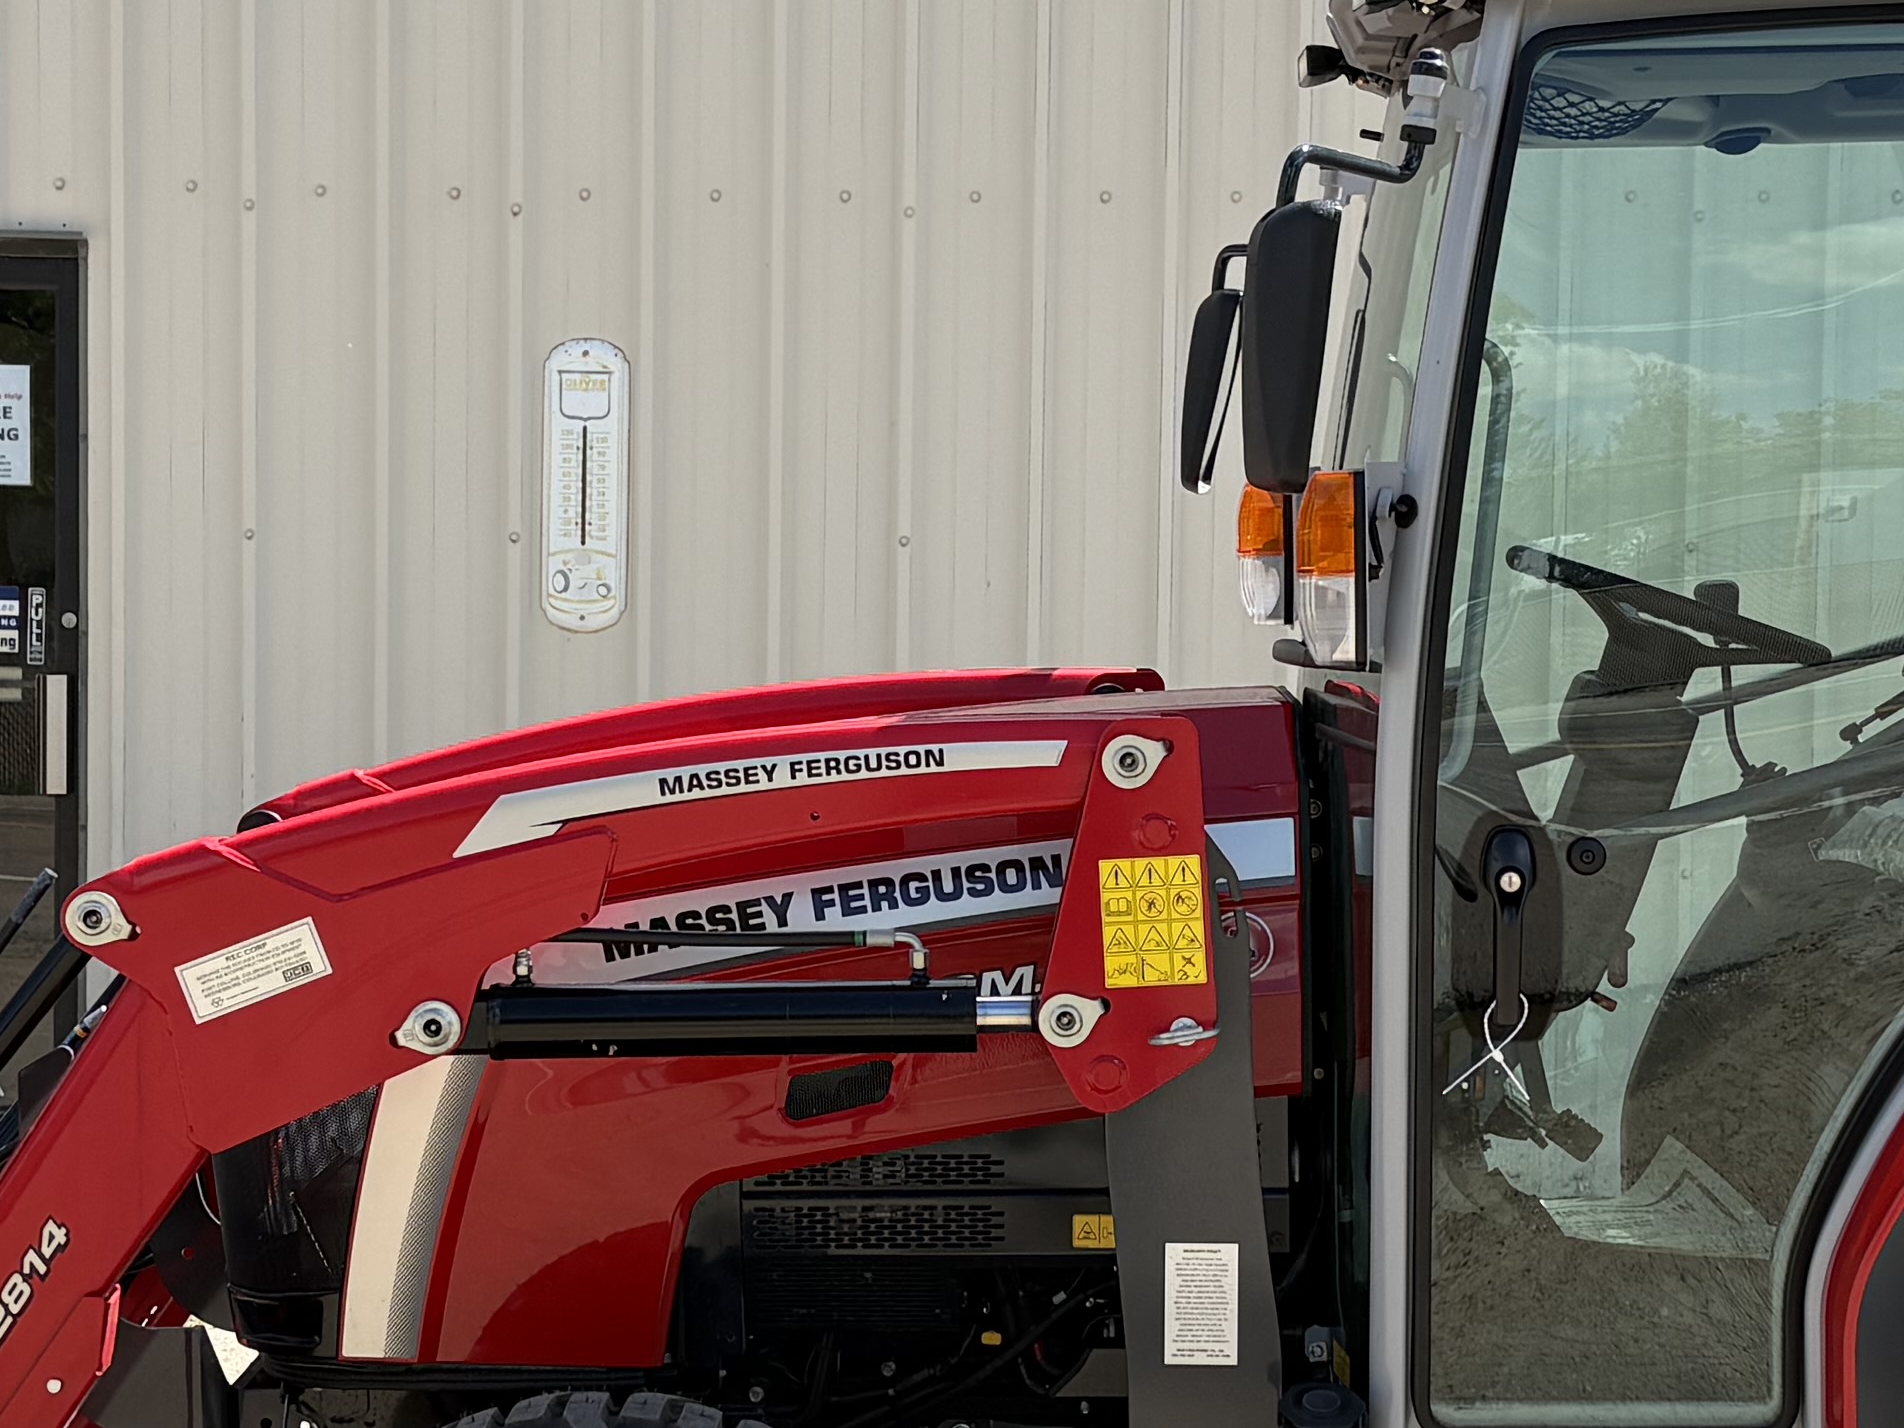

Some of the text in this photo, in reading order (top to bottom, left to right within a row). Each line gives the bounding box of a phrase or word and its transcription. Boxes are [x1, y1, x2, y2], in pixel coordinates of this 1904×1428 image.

[31, 594, 43, 645] PULL
[658, 748, 945, 797] MASSEY FERGUSON
[601, 854, 1064, 963] MASSEY FERGUSON
